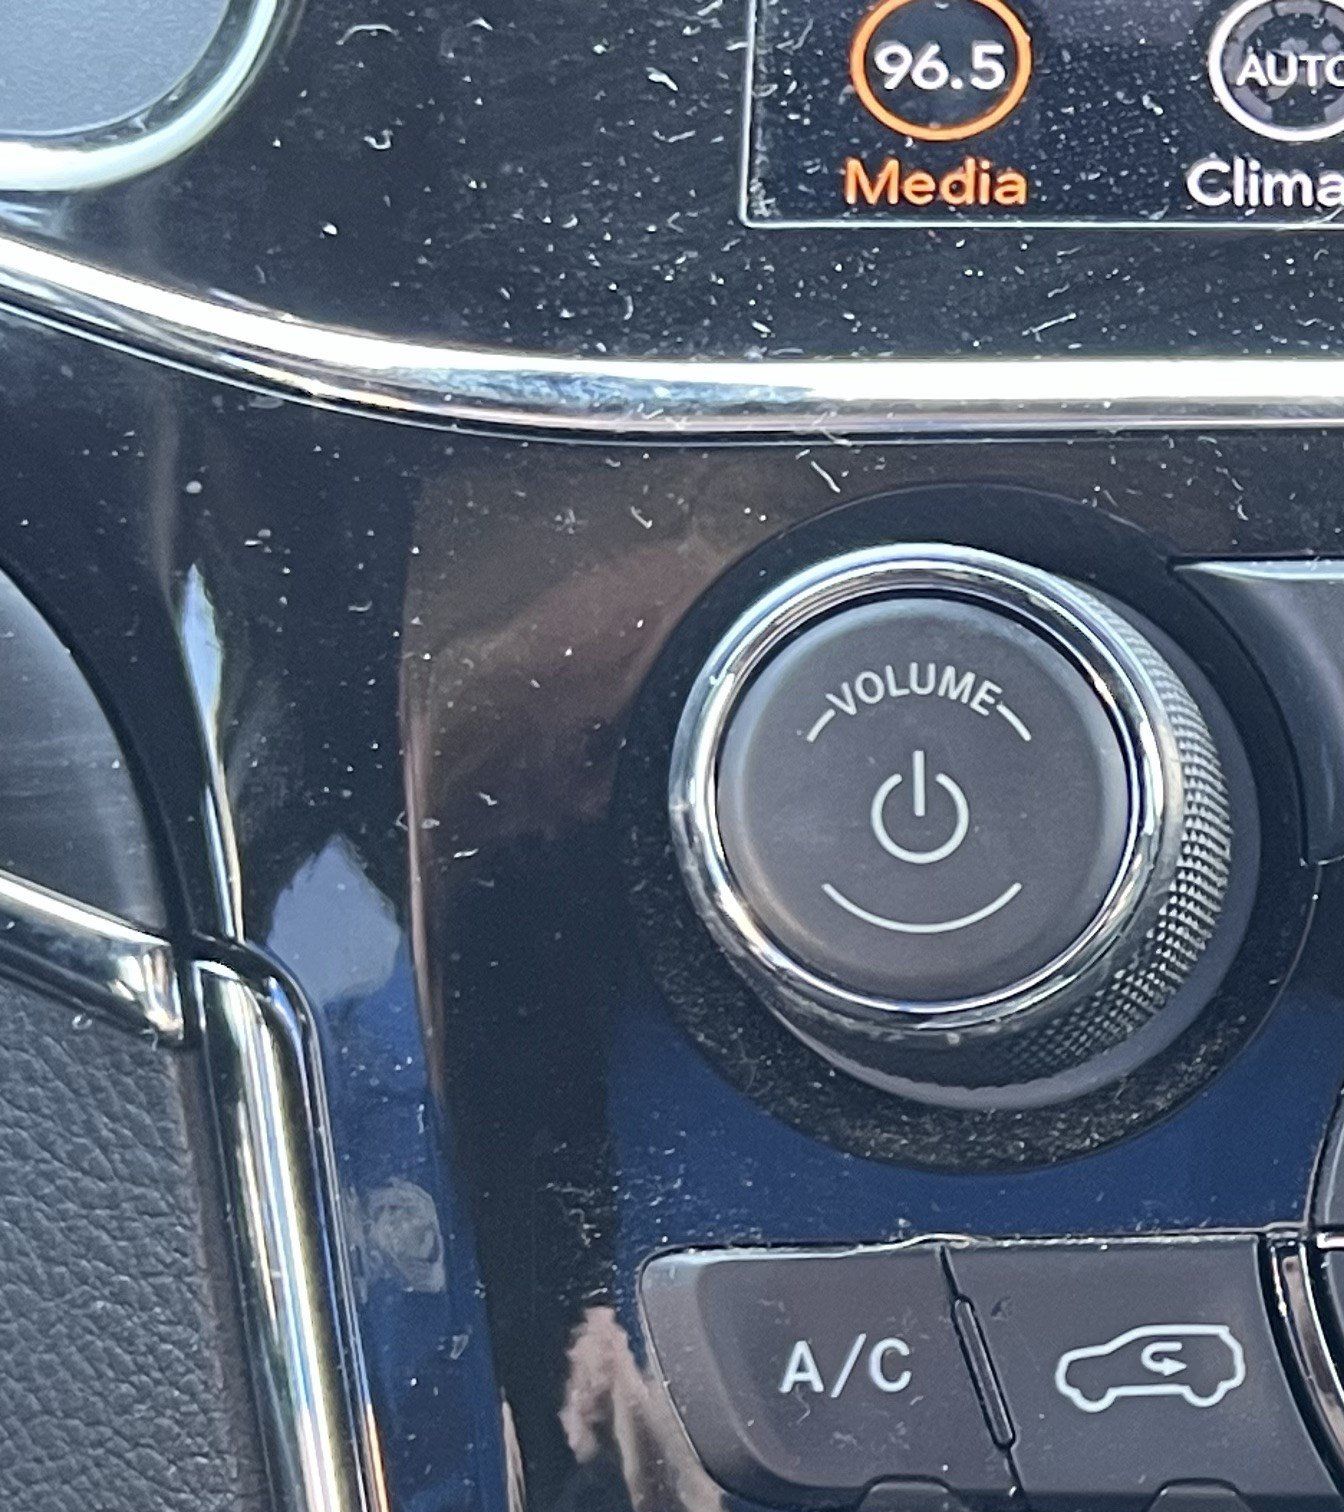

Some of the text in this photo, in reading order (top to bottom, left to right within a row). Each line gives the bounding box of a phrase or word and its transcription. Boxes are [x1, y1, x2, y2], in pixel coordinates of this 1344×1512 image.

[874, 43, 1006, 91] 96.5
[842, 158, 1028, 206] Media
[825, 661, 1003, 717] VOLUME
[779, 1333, 912, 1398] A/C
